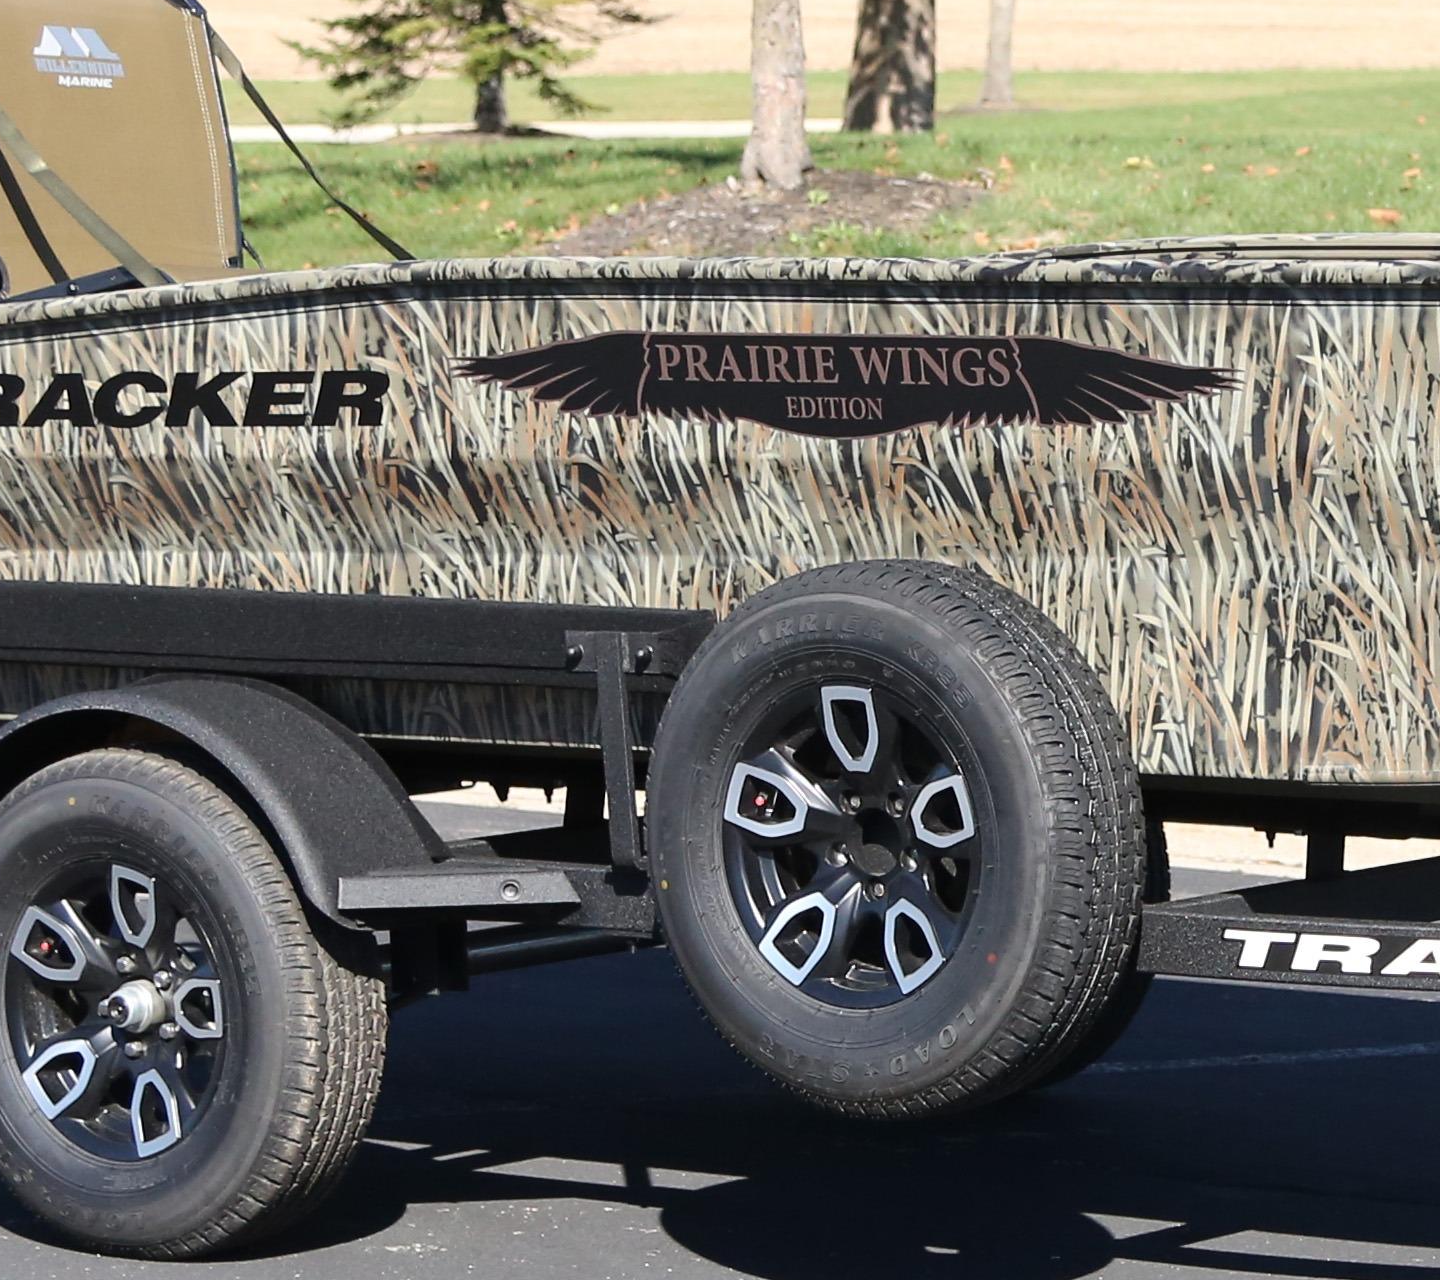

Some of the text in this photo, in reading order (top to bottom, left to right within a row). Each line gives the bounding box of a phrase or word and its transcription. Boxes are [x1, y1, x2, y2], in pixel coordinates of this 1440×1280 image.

[58, 75, 113, 89] MARINE
[654, 343, 1012, 387] PRAIRIE WINGS
[784, 396, 883, 420] EDITION
[731, 613, 885, 665] KARRIER
